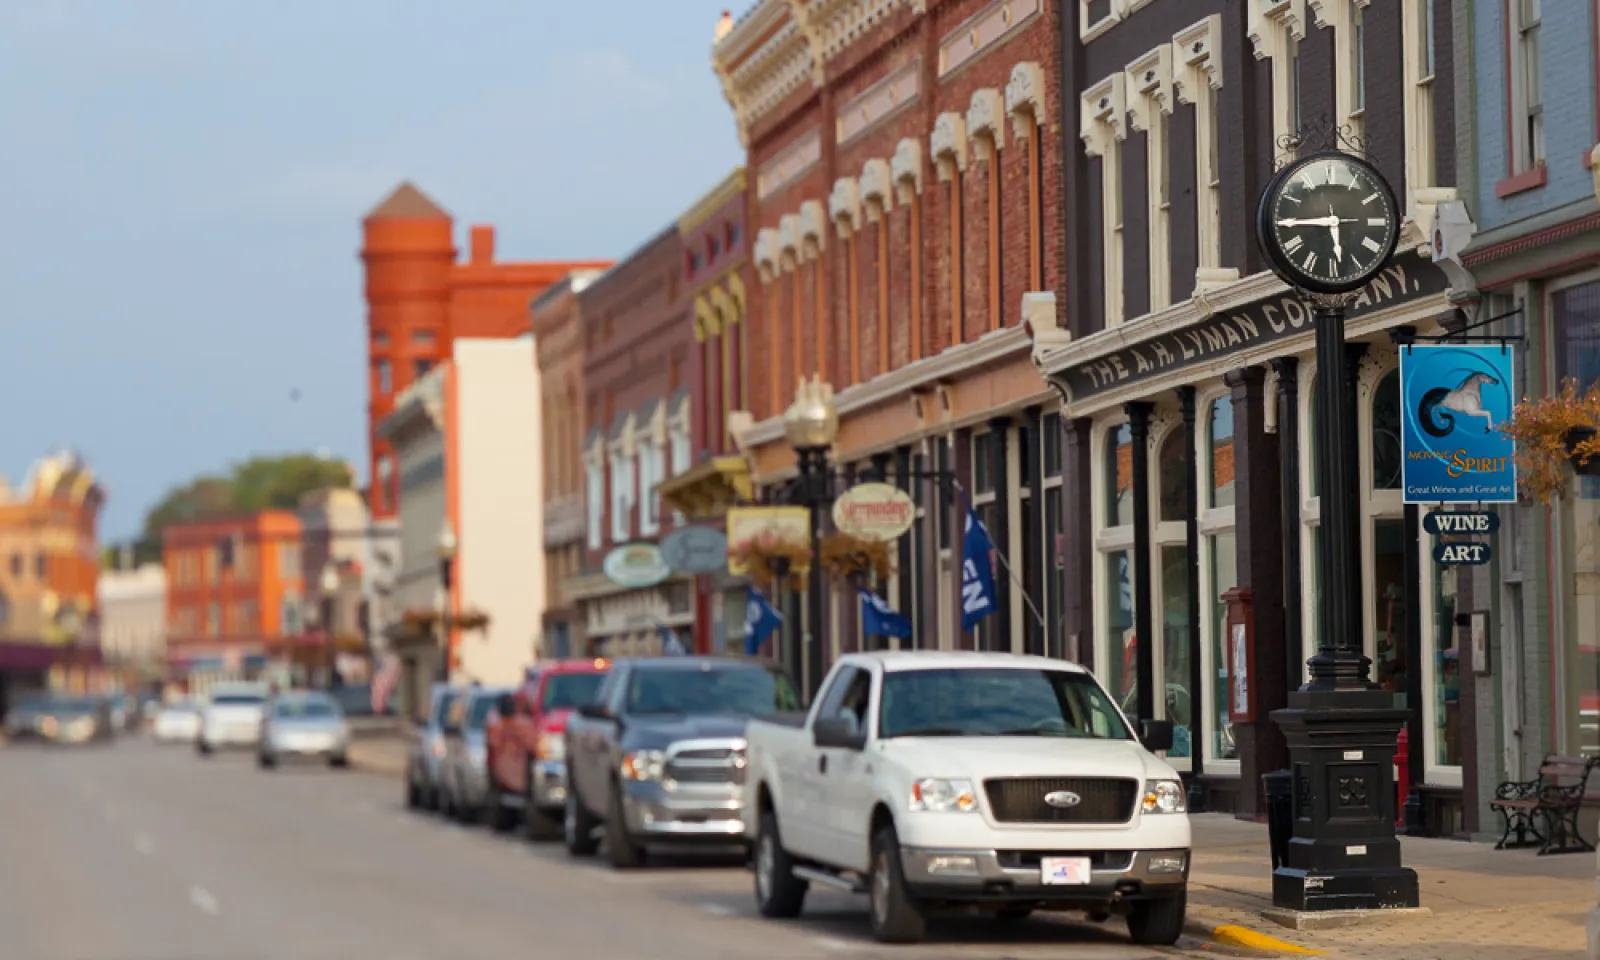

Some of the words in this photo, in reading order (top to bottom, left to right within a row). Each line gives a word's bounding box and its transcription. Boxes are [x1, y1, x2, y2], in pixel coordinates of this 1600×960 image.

[1080, 355, 1129, 389] THE
[1173, 313, 1259, 361] LYMAN
[1262, 264, 1420, 334] COANY.
[1408, 450, 1452, 460] MOVING
[1448, 450, 1507, 477] SPIRIT
[1408, 486, 1429, 494] Great
[1432, 486, 1456, 494] Wines
[1459, 485, 1473, 494] and
[1475, 485, 1496, 494] Great
[1434, 514, 1490, 531] WINE
[1440, 545, 1484, 561] ART
